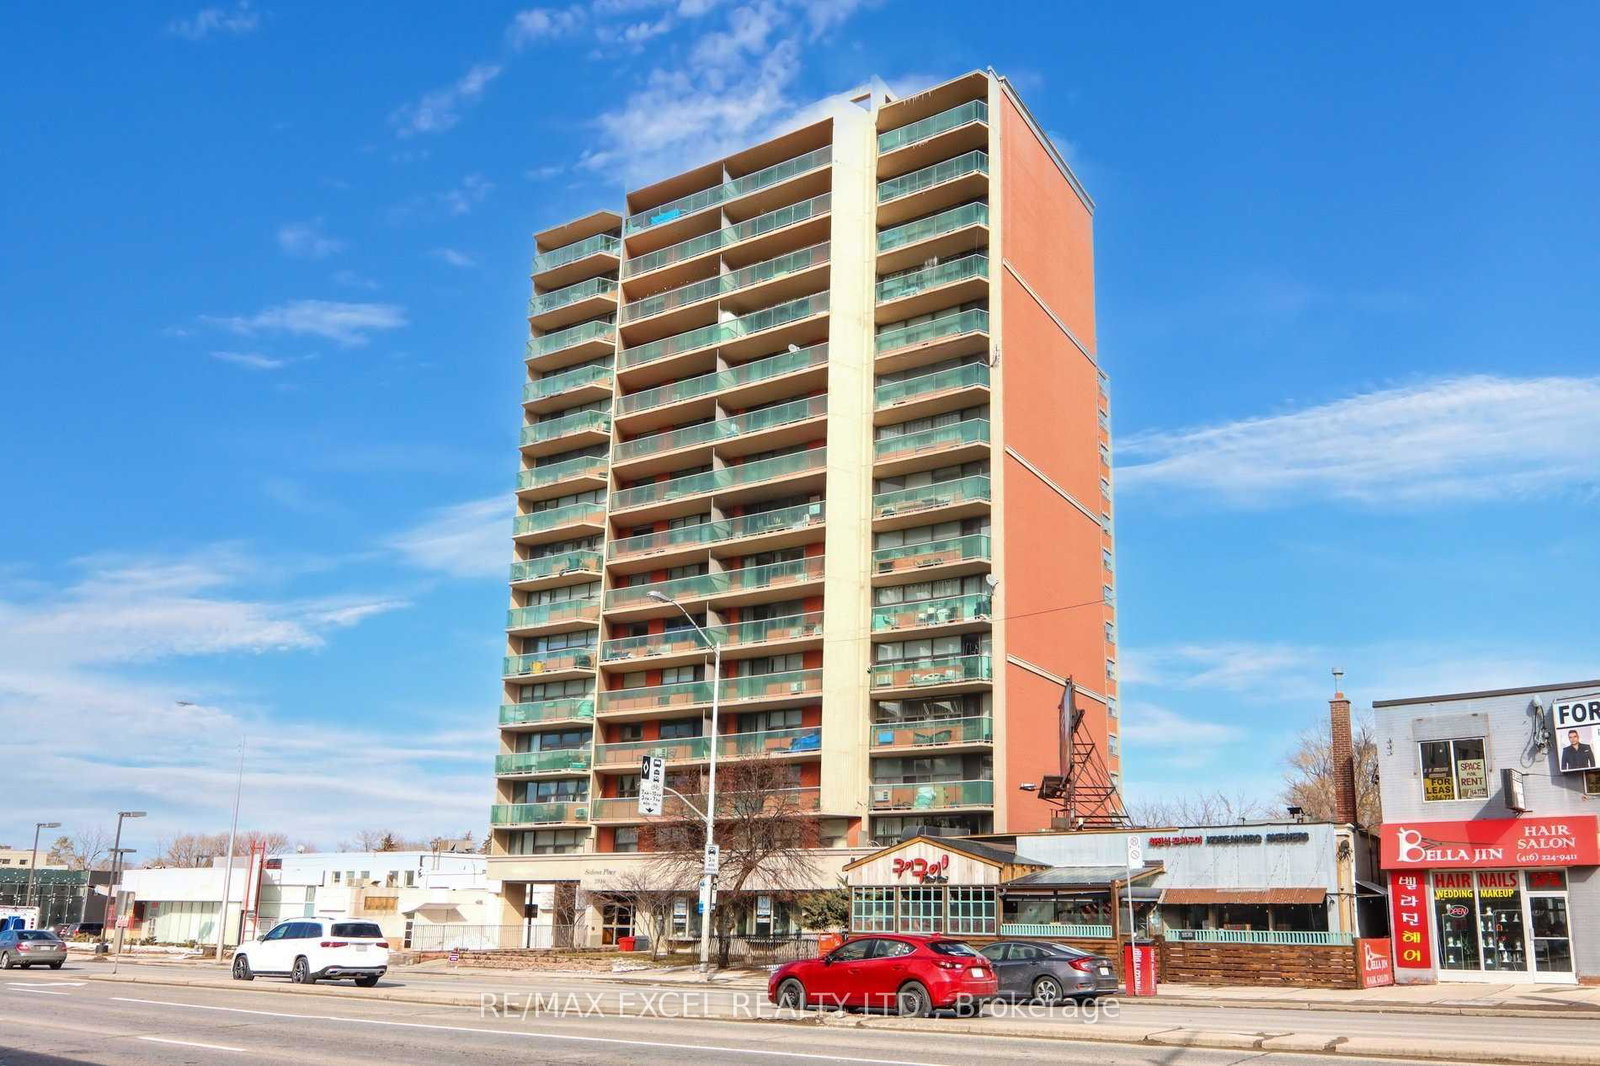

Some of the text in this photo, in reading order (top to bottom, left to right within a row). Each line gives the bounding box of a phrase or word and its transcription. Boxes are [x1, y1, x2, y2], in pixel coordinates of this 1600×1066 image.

[1460, 762, 1482, 771] SPACE
[1430, 778, 1451, 787] FOR
[1461, 777, 1483, 786] RENT
[1524, 825, 1571, 837] HAIR
[1517, 837, 1576, 850] SALON
[1472, 848, 1504, 864] JIN
[1516, 852, 1539, 863] (416)
[1434, 873, 1471, 889] HAIR
[1479, 872, 1517, 888] NAILS
[1435, 888, 1515, 898] WEDDING MAKEUP
[1449, 907, 1467, 916] OPEN
